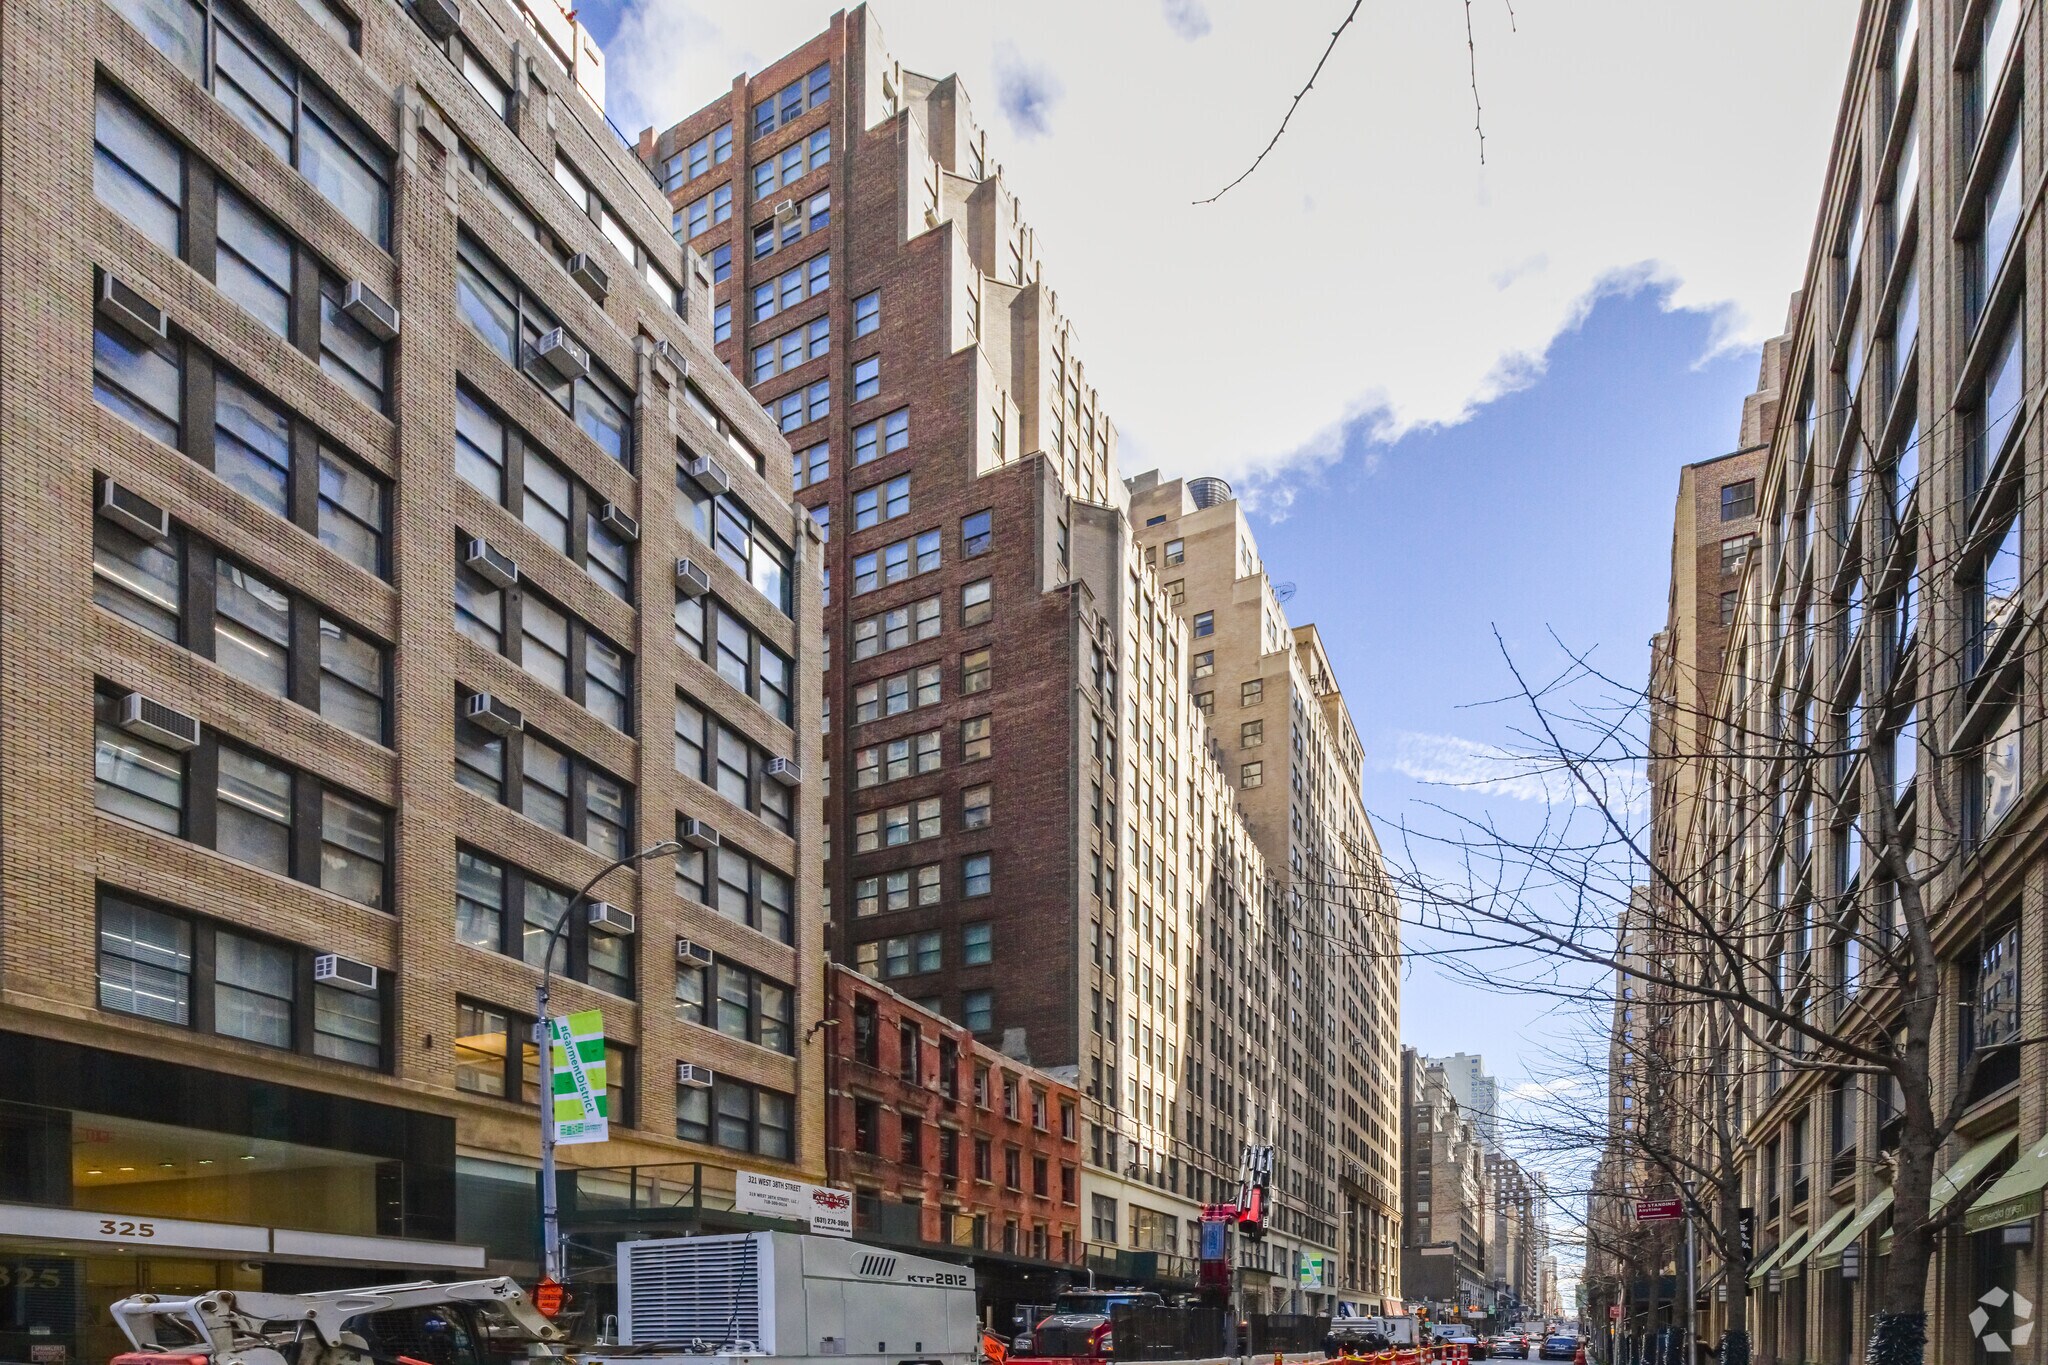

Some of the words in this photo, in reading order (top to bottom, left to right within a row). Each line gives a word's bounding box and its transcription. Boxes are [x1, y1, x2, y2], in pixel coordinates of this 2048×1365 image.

[560, 1025, 595, 1113] #GarmentDistrict
[748, 1175, 757, 1185] 321
[758, 1178, 772, 1187] WEST
[772, 1180, 785, 1190] 38TH
[784, 1182, 802, 1192] STREET
[815, 1195, 847, 1205] ARSENAL
[99, 1219, 155, 1238] 325
